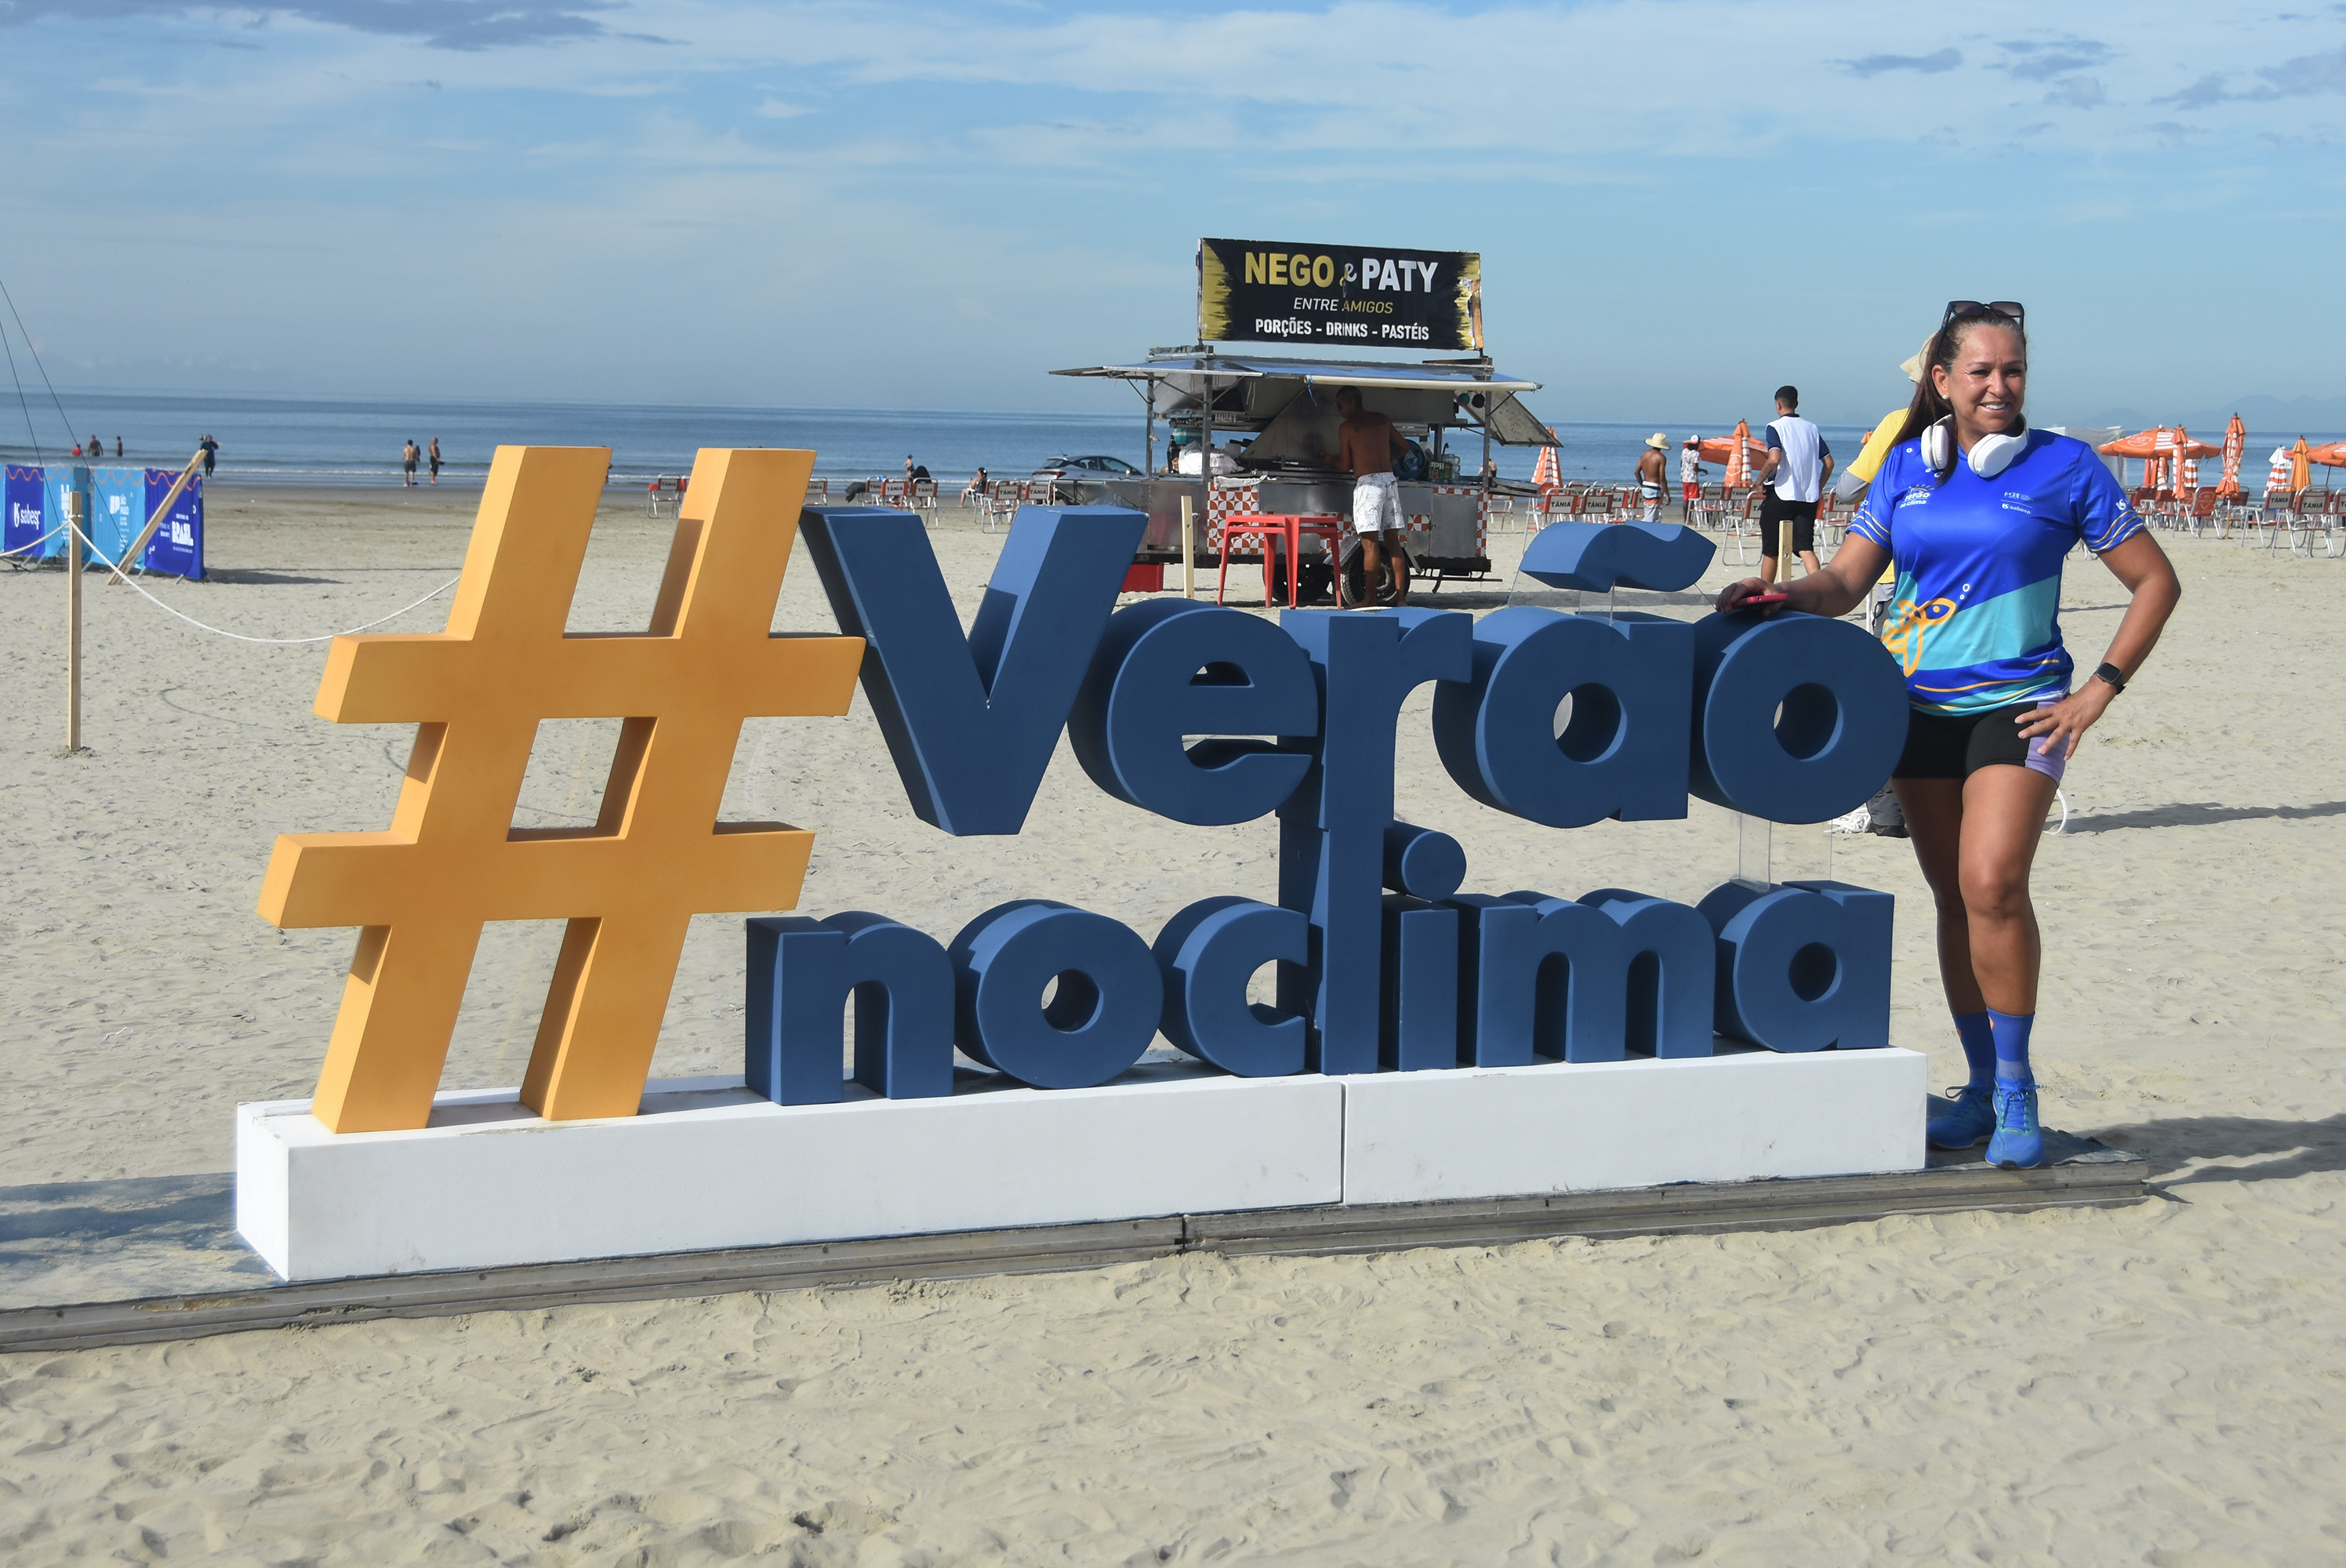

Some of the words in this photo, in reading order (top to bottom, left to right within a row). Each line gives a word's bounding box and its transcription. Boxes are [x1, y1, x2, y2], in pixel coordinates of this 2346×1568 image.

[1244, 252, 1334, 288] NEGO
[1362, 257, 1438, 293] PATY
[1294, 297, 1339, 312] ENTRE
[1342, 299, 1393, 314] AMIGOS
[1255, 316, 1312, 338] PORÇÕES
[1326, 321, 1368, 338] DRINKS
[1382, 322, 1429, 341] PASTÉIS
